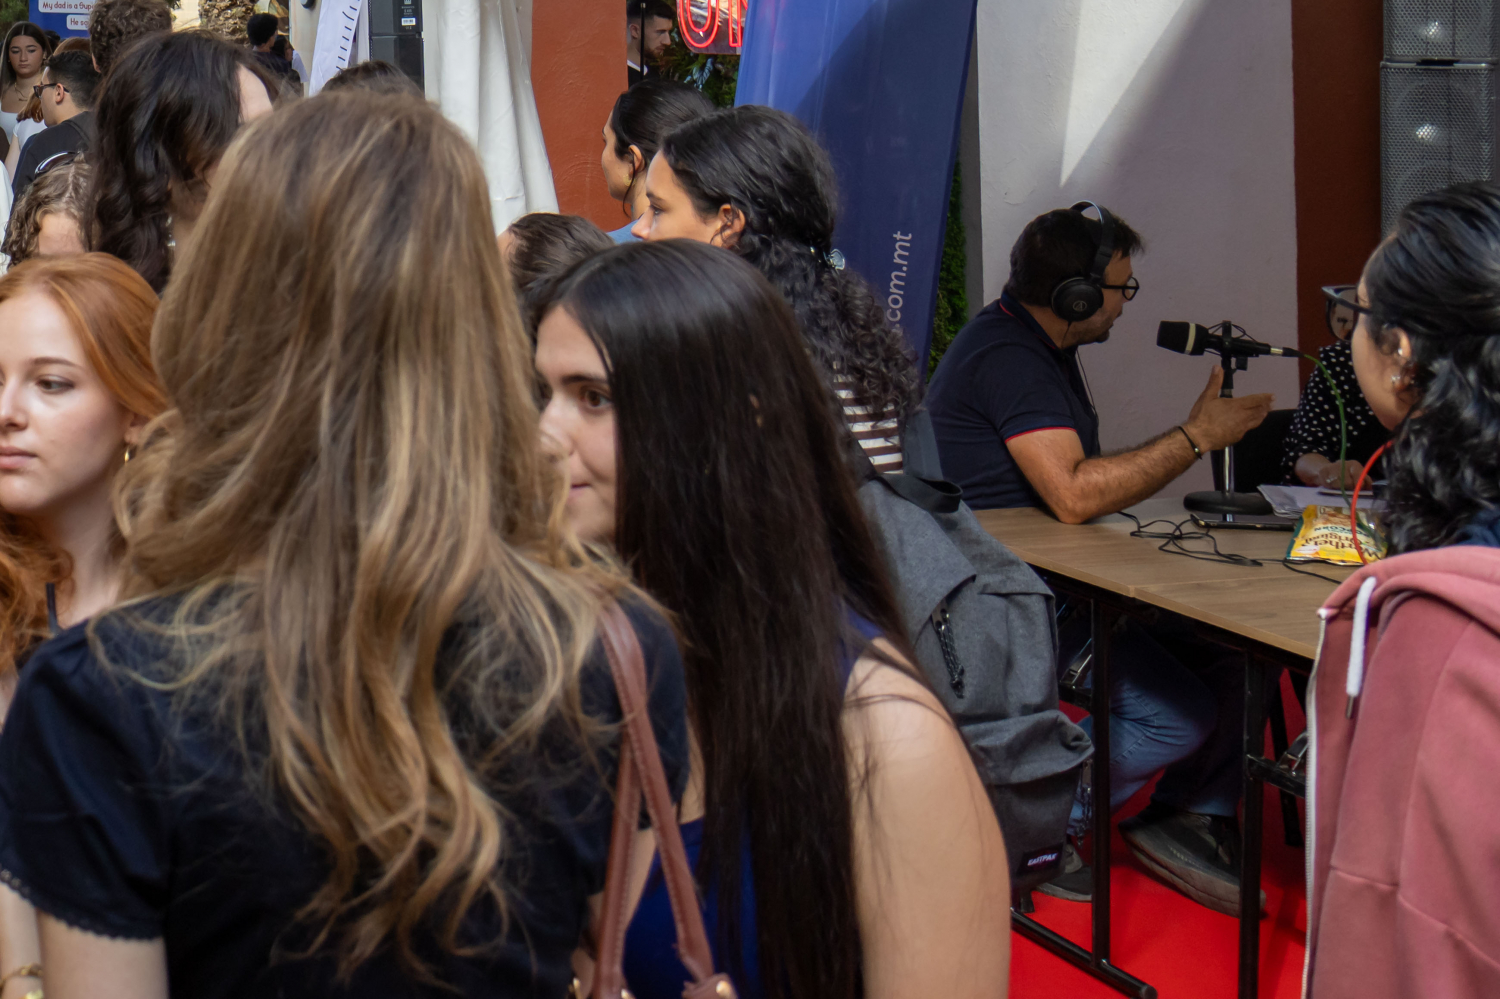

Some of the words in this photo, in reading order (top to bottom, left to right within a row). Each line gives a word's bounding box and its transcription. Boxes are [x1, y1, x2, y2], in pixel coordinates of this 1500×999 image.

[42, 1, 53, 10] My
[54, 1, 66, 9] dad
[66, 1, 73, 9] is
[70, 18, 78, 27] He
[1301, 539, 1381, 560] Wrther
